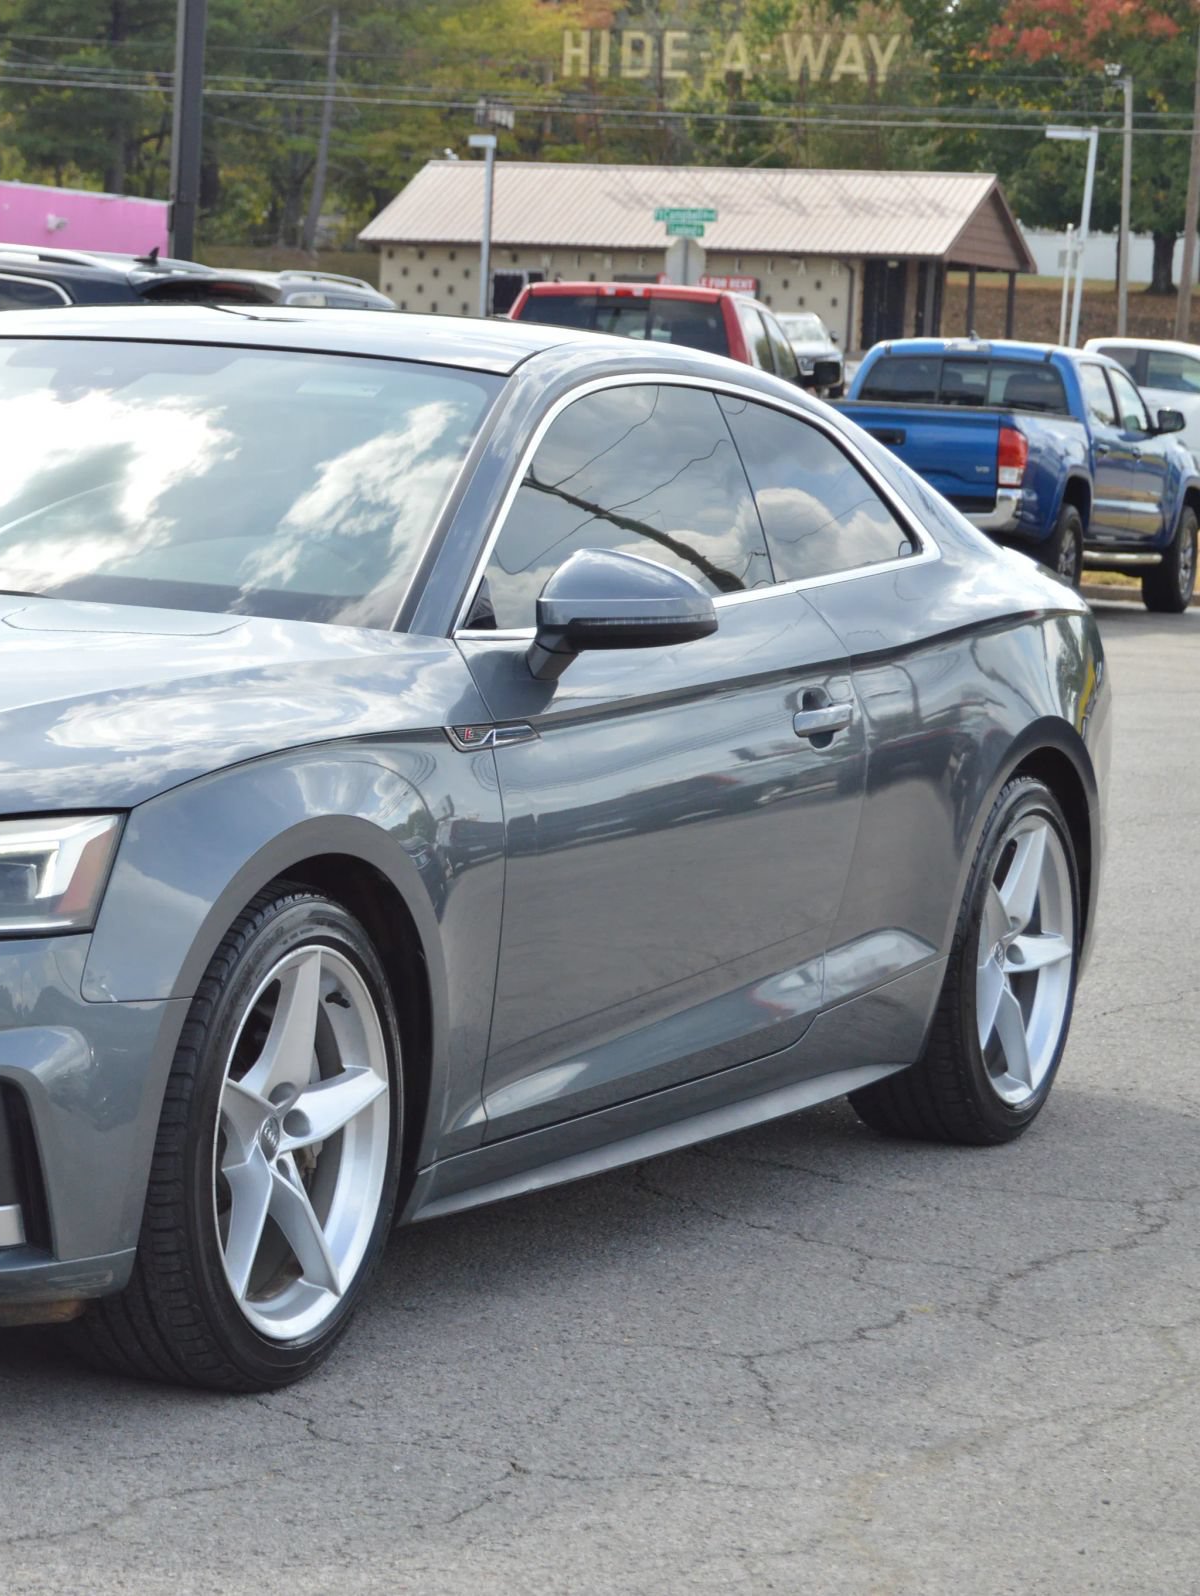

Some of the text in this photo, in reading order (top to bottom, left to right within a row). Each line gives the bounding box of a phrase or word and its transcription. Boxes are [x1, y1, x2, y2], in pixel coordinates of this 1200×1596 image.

[562, 30, 901, 82] HIDE-A-WAY
[709, 274, 728, 288] FOR
[730, 276, 755, 290] RENT
